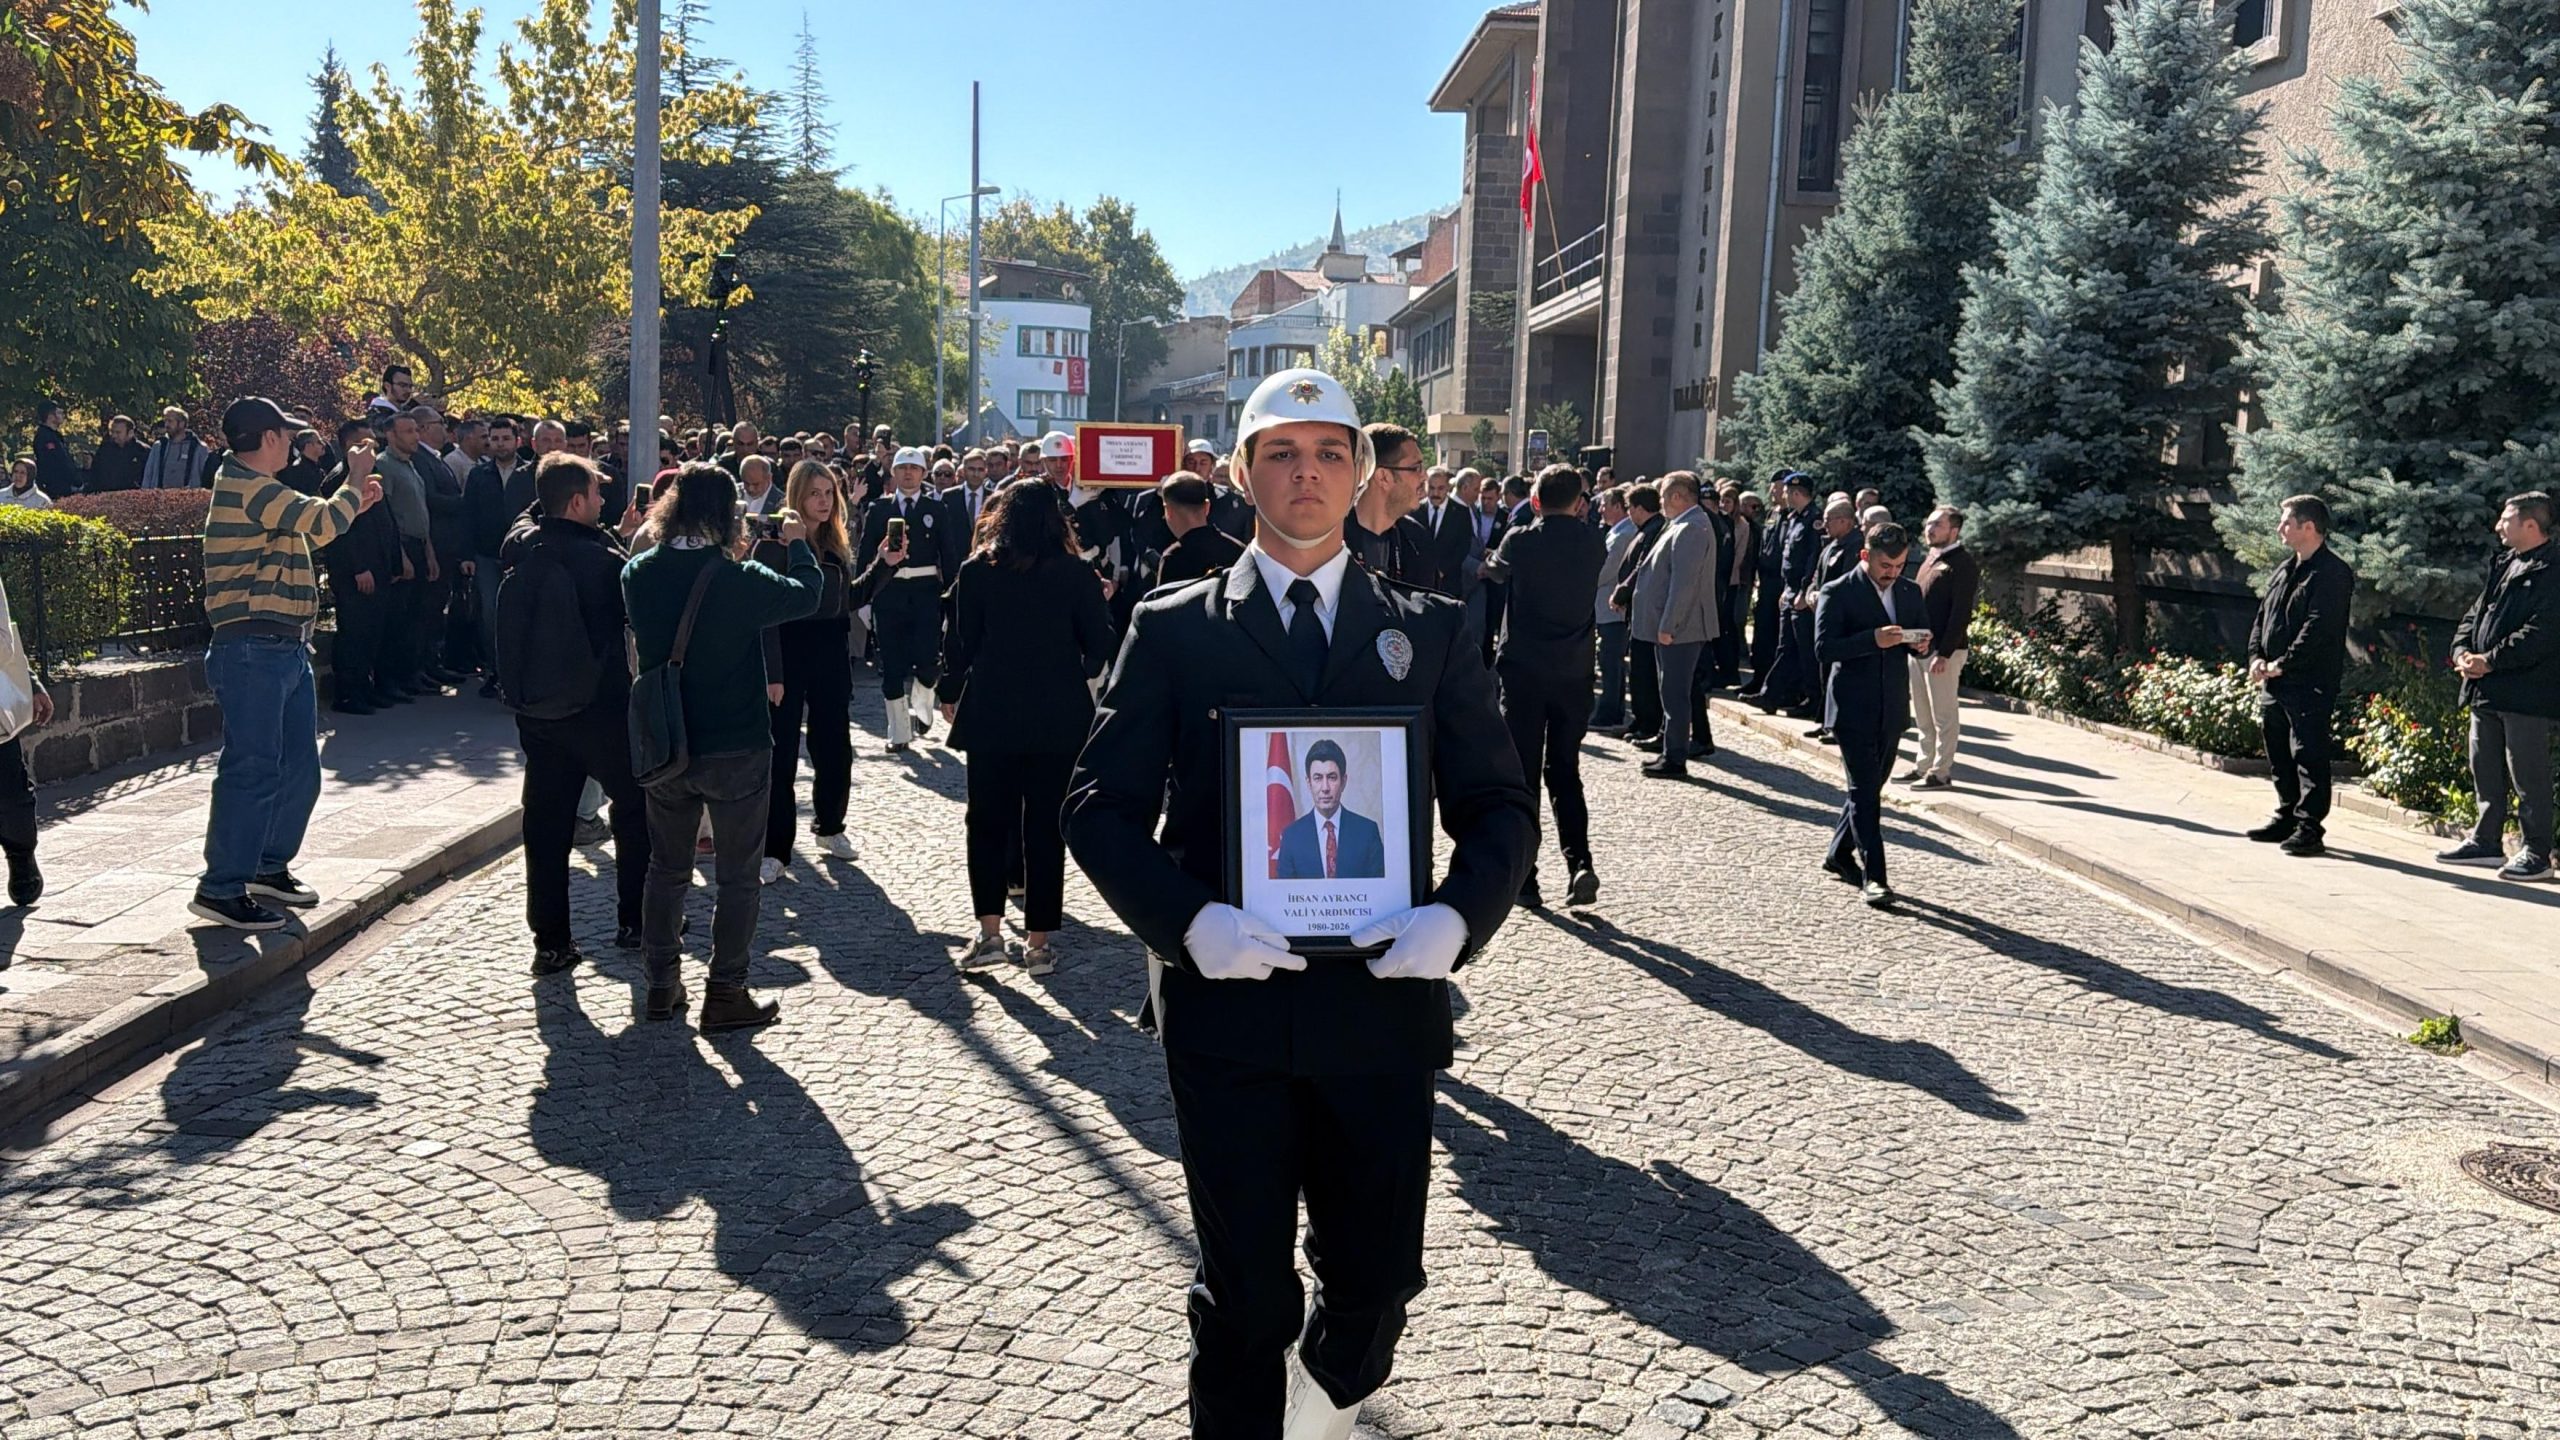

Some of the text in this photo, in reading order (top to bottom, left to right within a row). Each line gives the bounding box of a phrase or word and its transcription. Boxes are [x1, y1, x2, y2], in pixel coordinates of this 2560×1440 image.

[1288, 892, 1367, 903] İHSAN AYRANCI
[1284, 907, 1372, 917] VALİ YARDIMCISI
